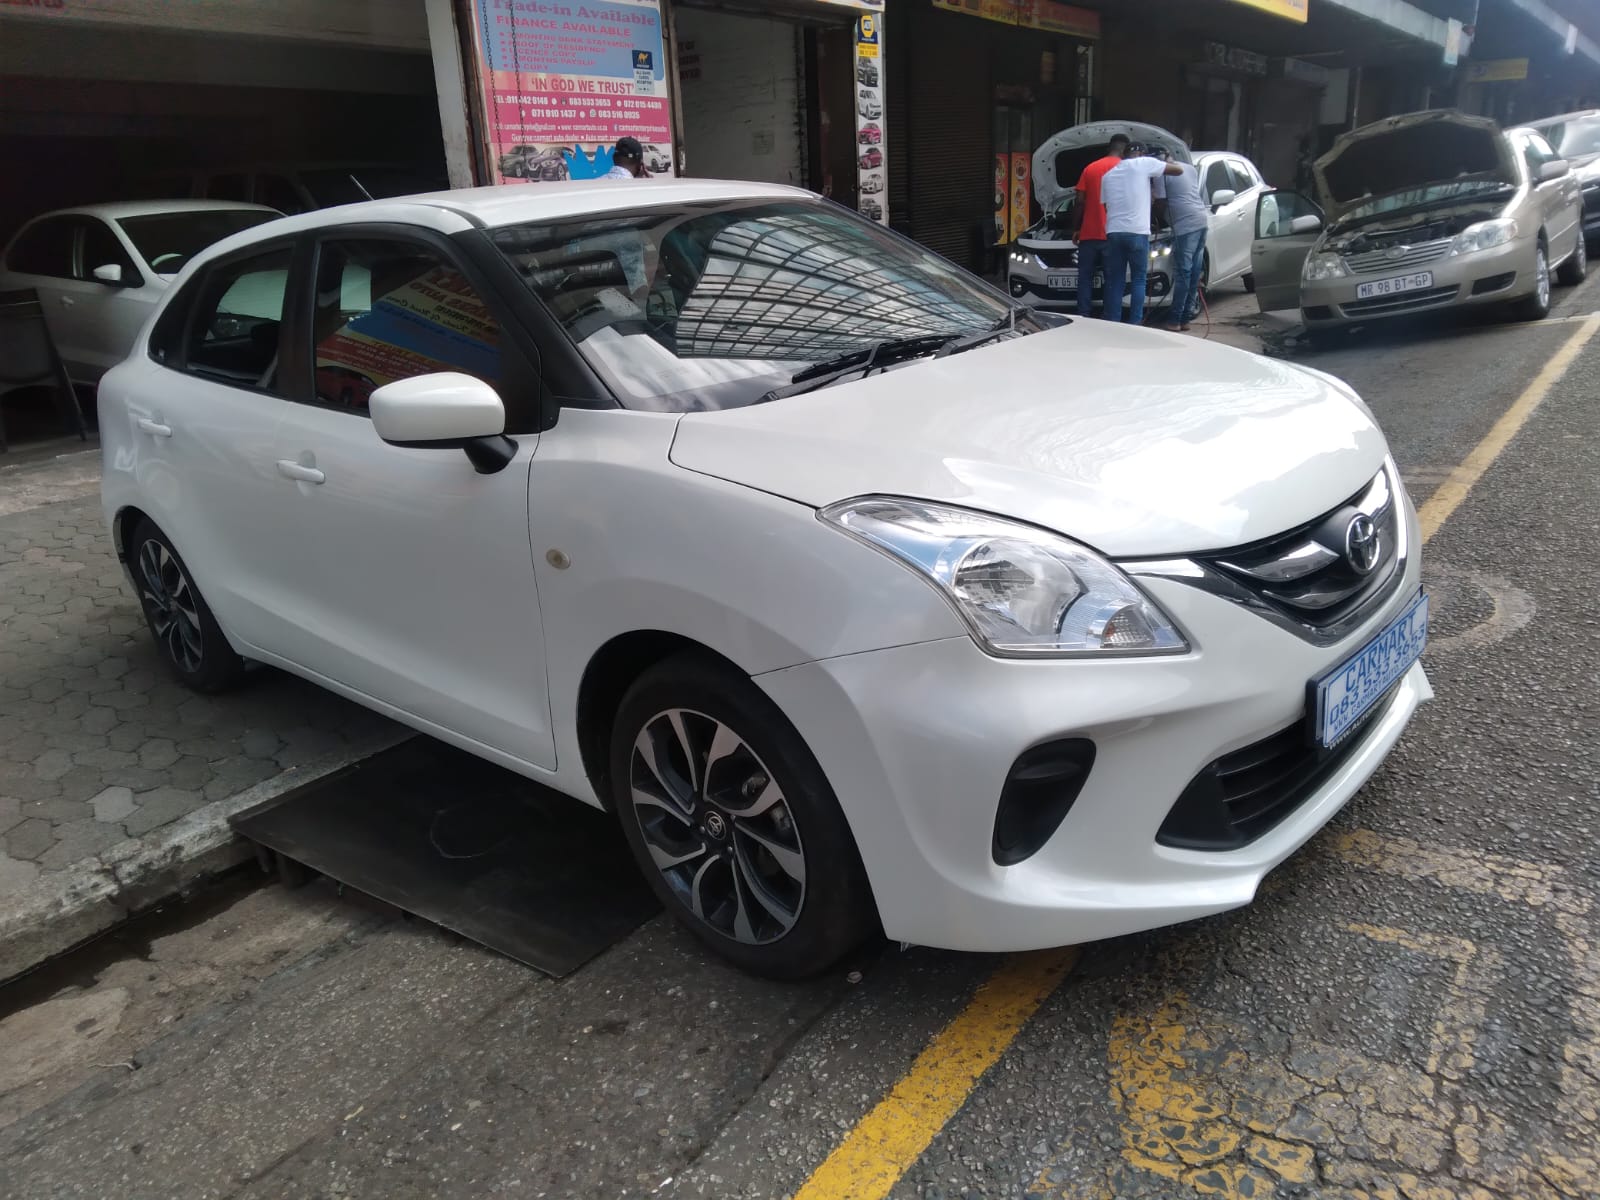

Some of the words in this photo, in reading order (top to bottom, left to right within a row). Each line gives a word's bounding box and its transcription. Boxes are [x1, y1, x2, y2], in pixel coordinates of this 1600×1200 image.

[493, 0, 572, 17] Trade-in
[576, 7, 656, 26] Available
[496, 15, 557, 30] FINANCE
[563, 22, 631, 38] AVAILABLE
[508, 40, 540, 48] PROOF
[558, 44, 607, 53] RESIDENCE
[516, 33, 556, 42] MONTHS
[558, 36, 583, 44] BANK
[587, 38, 635, 48] STATEMENT
[519, 56, 558, 64] MONTHS
[560, 58, 596, 66] PAYSLIP
[552, 50, 577, 58] COPY
[552, 80, 575, 92] GOD
[577, 80, 594, 92] WE
[532, 109, 544, 118] 071
[1050, 278, 1058, 286] KV
[1378, 281, 1390, 293] 98
[1394, 278, 1407, 290] BT
[1415, 274, 1428, 286] GP
[1346, 610, 1417, 693] CARMART
[1330, 686, 1360, 726] 083
[1364, 657, 1390, 692] 533
[1394, 624, 1425, 664] 3653
